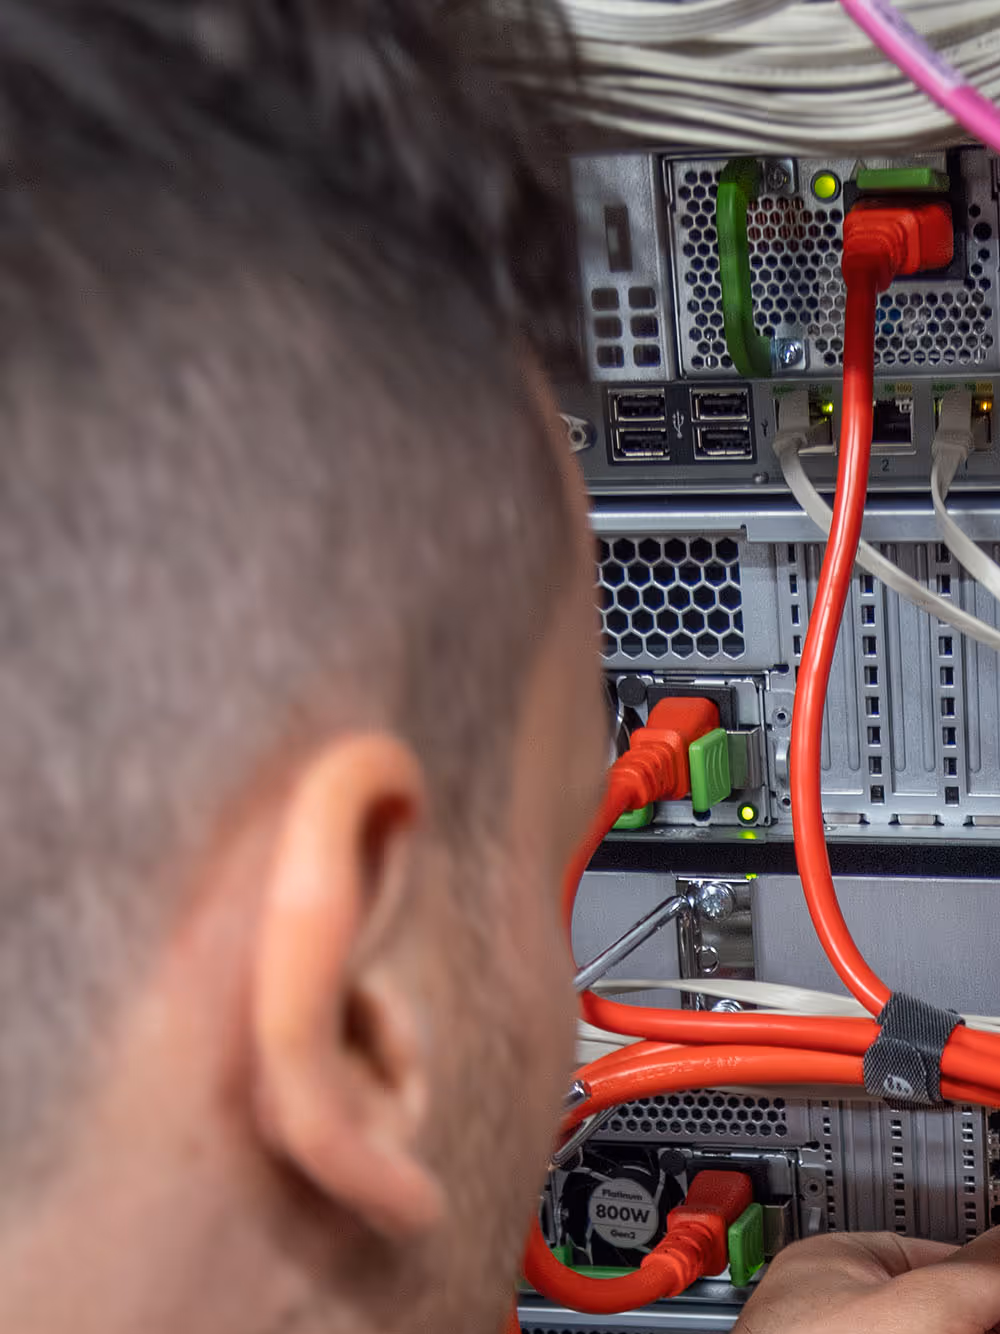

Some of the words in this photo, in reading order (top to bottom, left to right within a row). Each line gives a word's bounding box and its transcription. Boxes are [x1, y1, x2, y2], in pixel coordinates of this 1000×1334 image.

[601, 1188, 643, 1201] Platinum
[595, 1203, 650, 1224] 800W
[610, 1229, 636, 1241] Gen2
